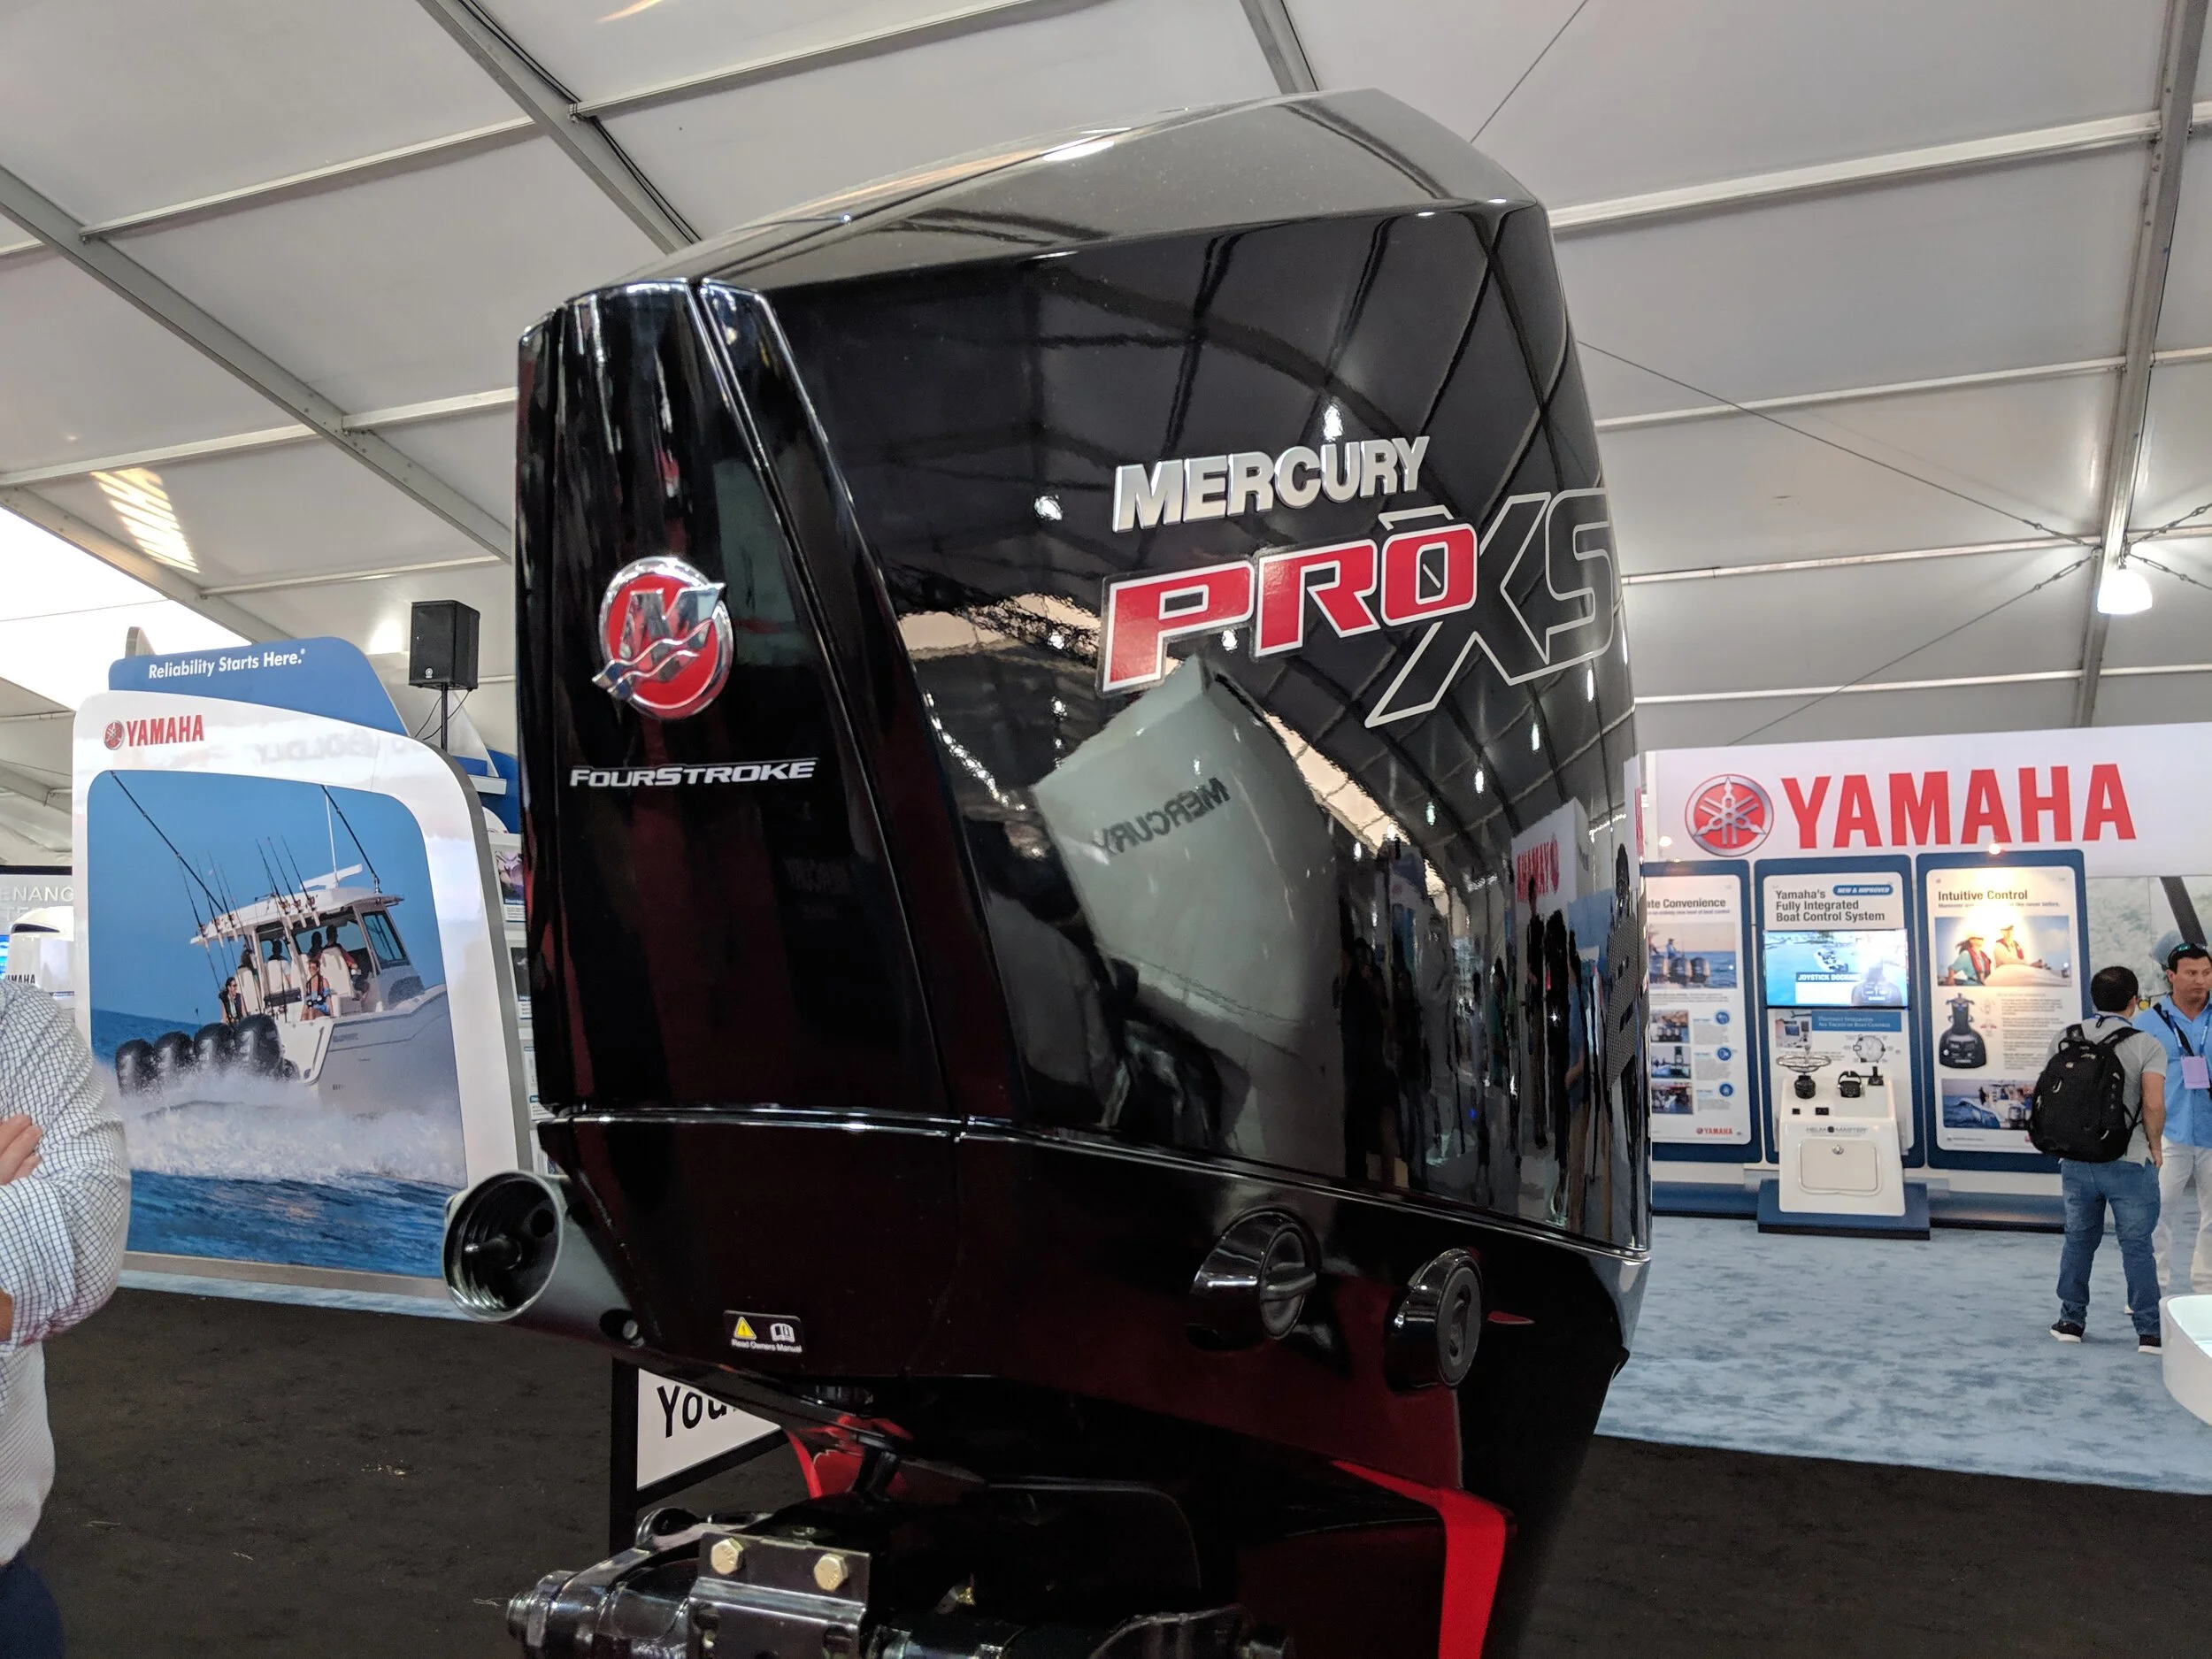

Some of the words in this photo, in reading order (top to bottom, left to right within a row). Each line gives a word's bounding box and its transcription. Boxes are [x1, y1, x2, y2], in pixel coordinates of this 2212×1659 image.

[1112, 435, 1430, 533] MERCURY
[1102, 522, 1478, 693] PRO
[1364, 487, 1615, 728] XS
[149, 659, 215, 680] Reliability
[219, 655, 259, 672] Starts
[127, 714, 204, 747] YAMAHA
[1780, 764, 2138, 849] YAMAHA
[1663, 897, 1726, 909] Convenience
[1775, 889, 1825, 899] Yamaha's
[1938, 890, 1984, 901] Intuitive
[1987, 889, 2028, 900] Control
[1776, 901, 1801, 912] Fully
[1804, 900, 1859, 912] Integrated
[1776, 912, 1800, 922] Boat
[1803, 911, 1842, 921] Control
[1845, 911, 1885, 922] System
[731, 1339, 749, 1349] Read
[750, 1341, 776, 1352] Owners
[776, 1343, 803, 1353] Manual
[657, 1385, 738, 1439] You
